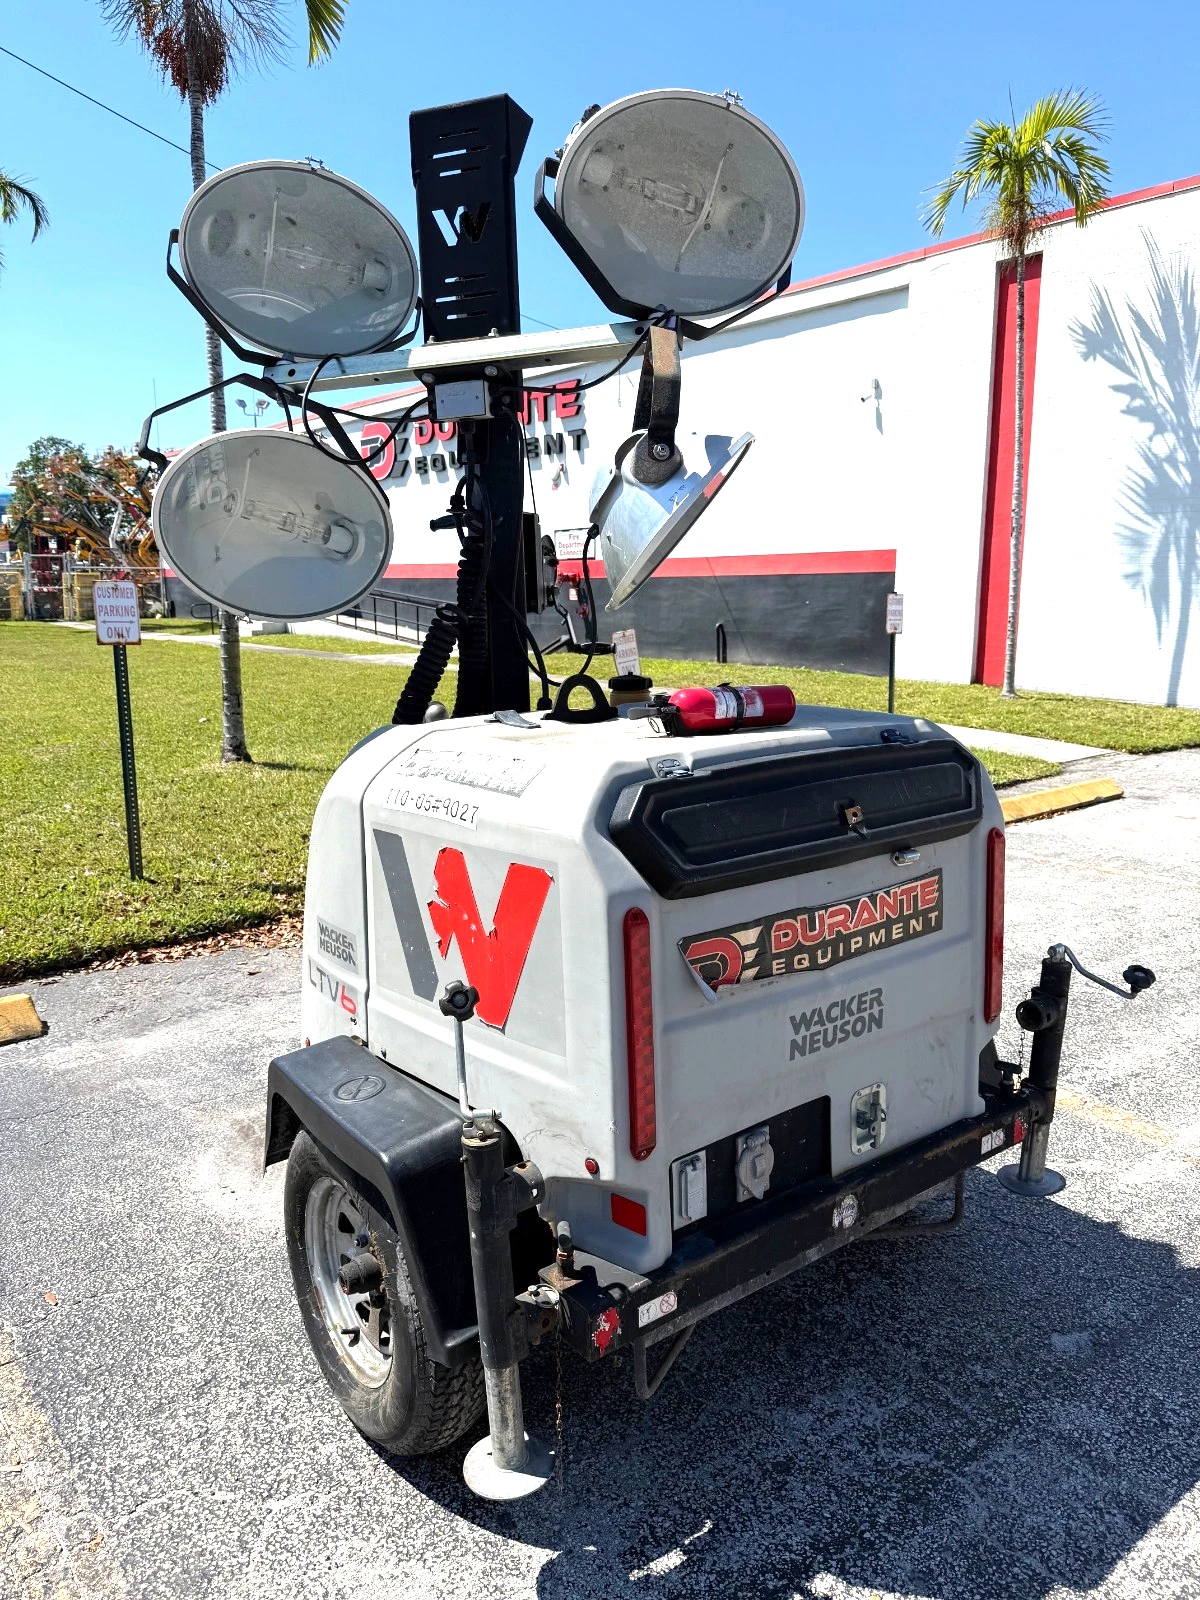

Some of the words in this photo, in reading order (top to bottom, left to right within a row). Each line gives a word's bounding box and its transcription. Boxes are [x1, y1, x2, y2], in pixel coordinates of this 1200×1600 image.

[414, 429, 587, 475] EQUENT
[96, 586, 134, 599] CUSTOMER
[98, 605, 136, 617] PARKING
[106, 626, 131, 639] ONLY
[318, 922, 355, 953] WACKER
[771, 875, 940, 955] DURANTE
[319, 936, 357, 967] NEUSON
[772, 911, 940, 976] EQUIPMENT
[308, 957, 357, 1015] LTV6
[788, 987, 885, 1036] WACKER
[788, 1008, 885, 1062] NEUSON
